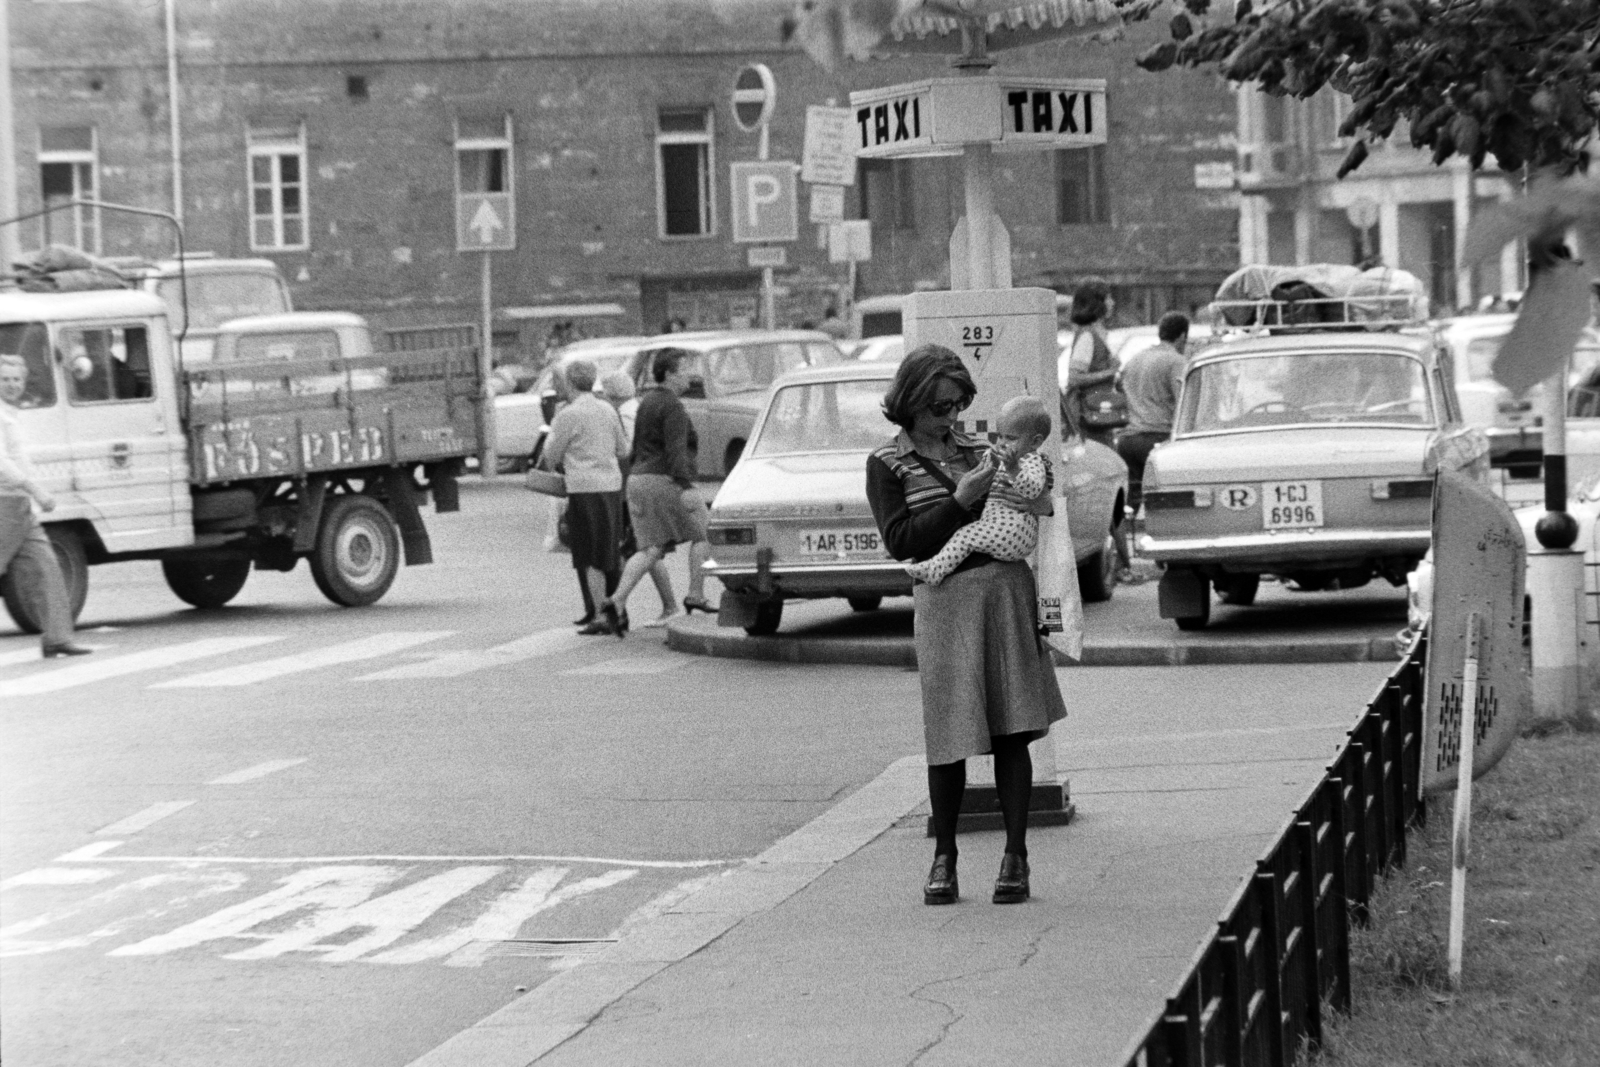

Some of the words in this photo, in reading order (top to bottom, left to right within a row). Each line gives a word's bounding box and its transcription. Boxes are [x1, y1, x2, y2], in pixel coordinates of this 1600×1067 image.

[857, 97, 921, 148] TAXI
[1008, 91, 1092, 134] TAXI
[748, 175, 780, 227] P
[962, 325, 993, 340] 283
[1229, 489, 1248, 506] R
[1271, 506, 1315, 524] 6996
